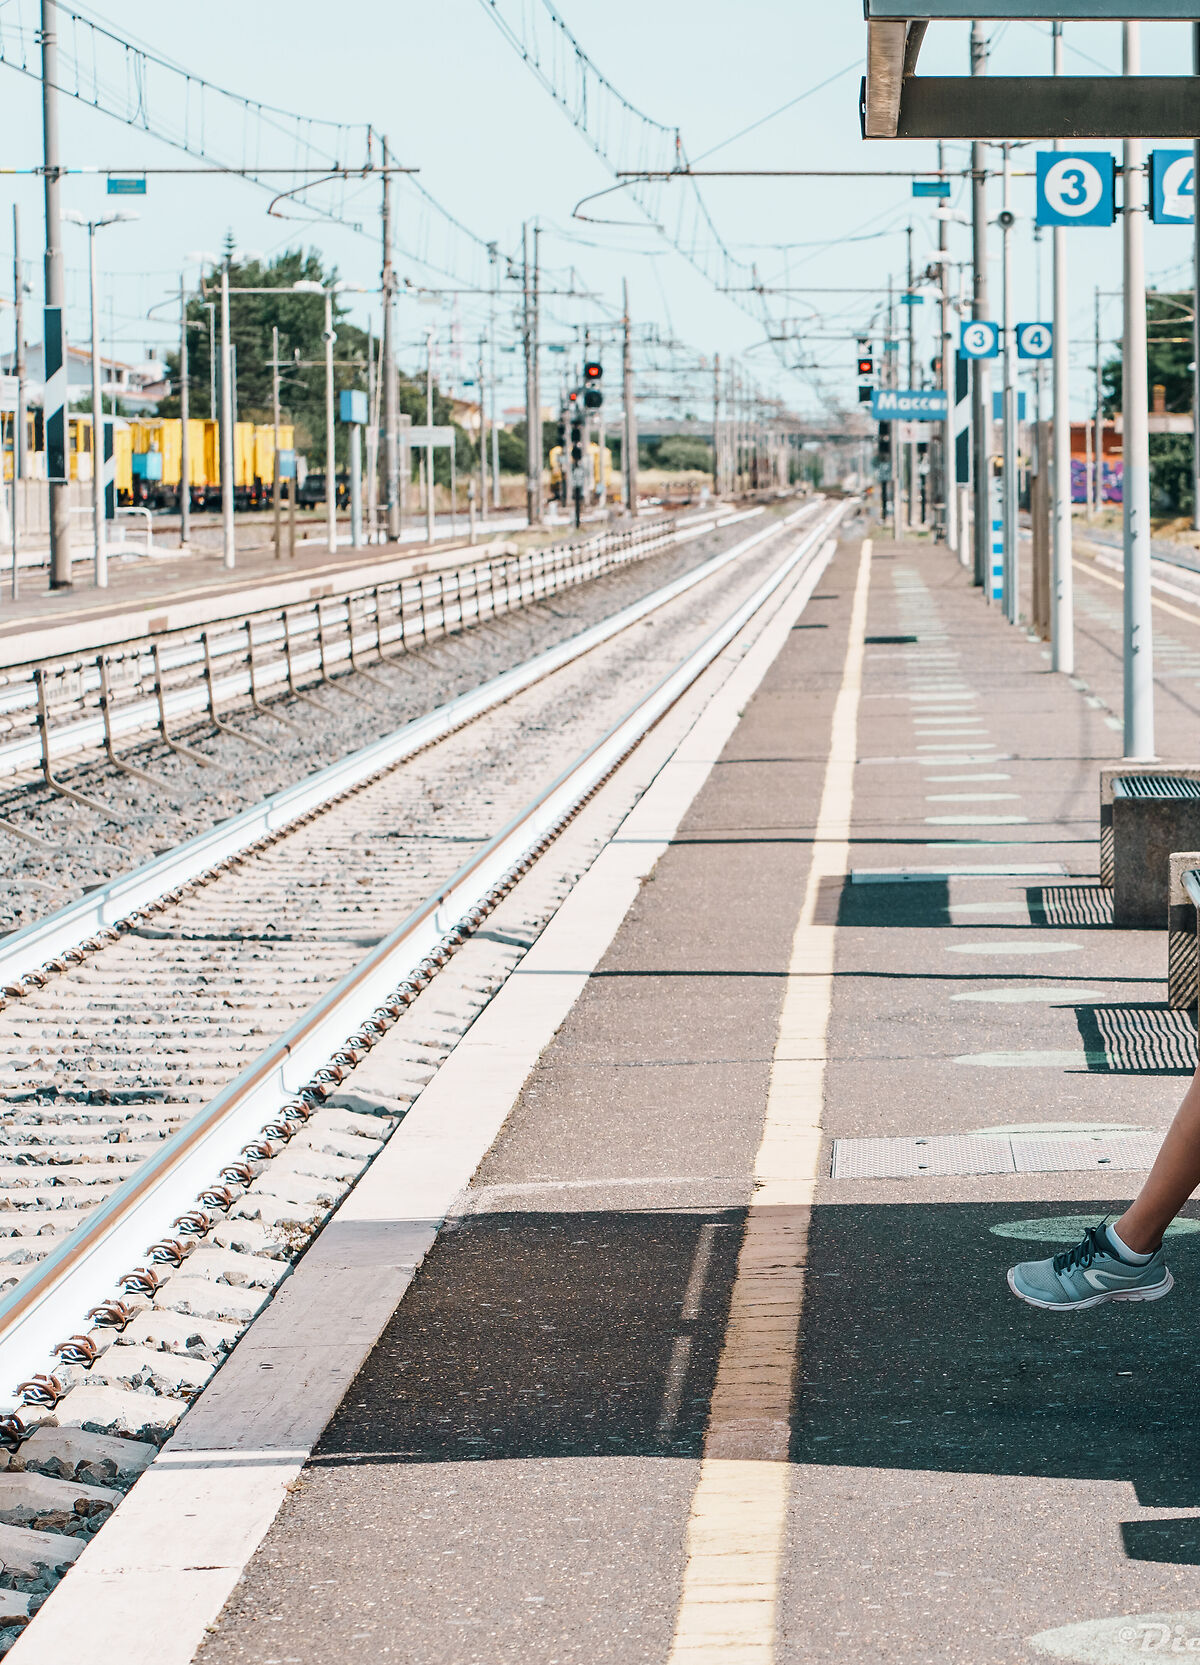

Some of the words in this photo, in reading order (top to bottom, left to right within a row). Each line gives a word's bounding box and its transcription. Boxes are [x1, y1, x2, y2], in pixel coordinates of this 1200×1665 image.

[1060, 169, 1087, 206] 3
[973, 330, 985, 348] 3
[1029, 331, 1043, 348] 4
